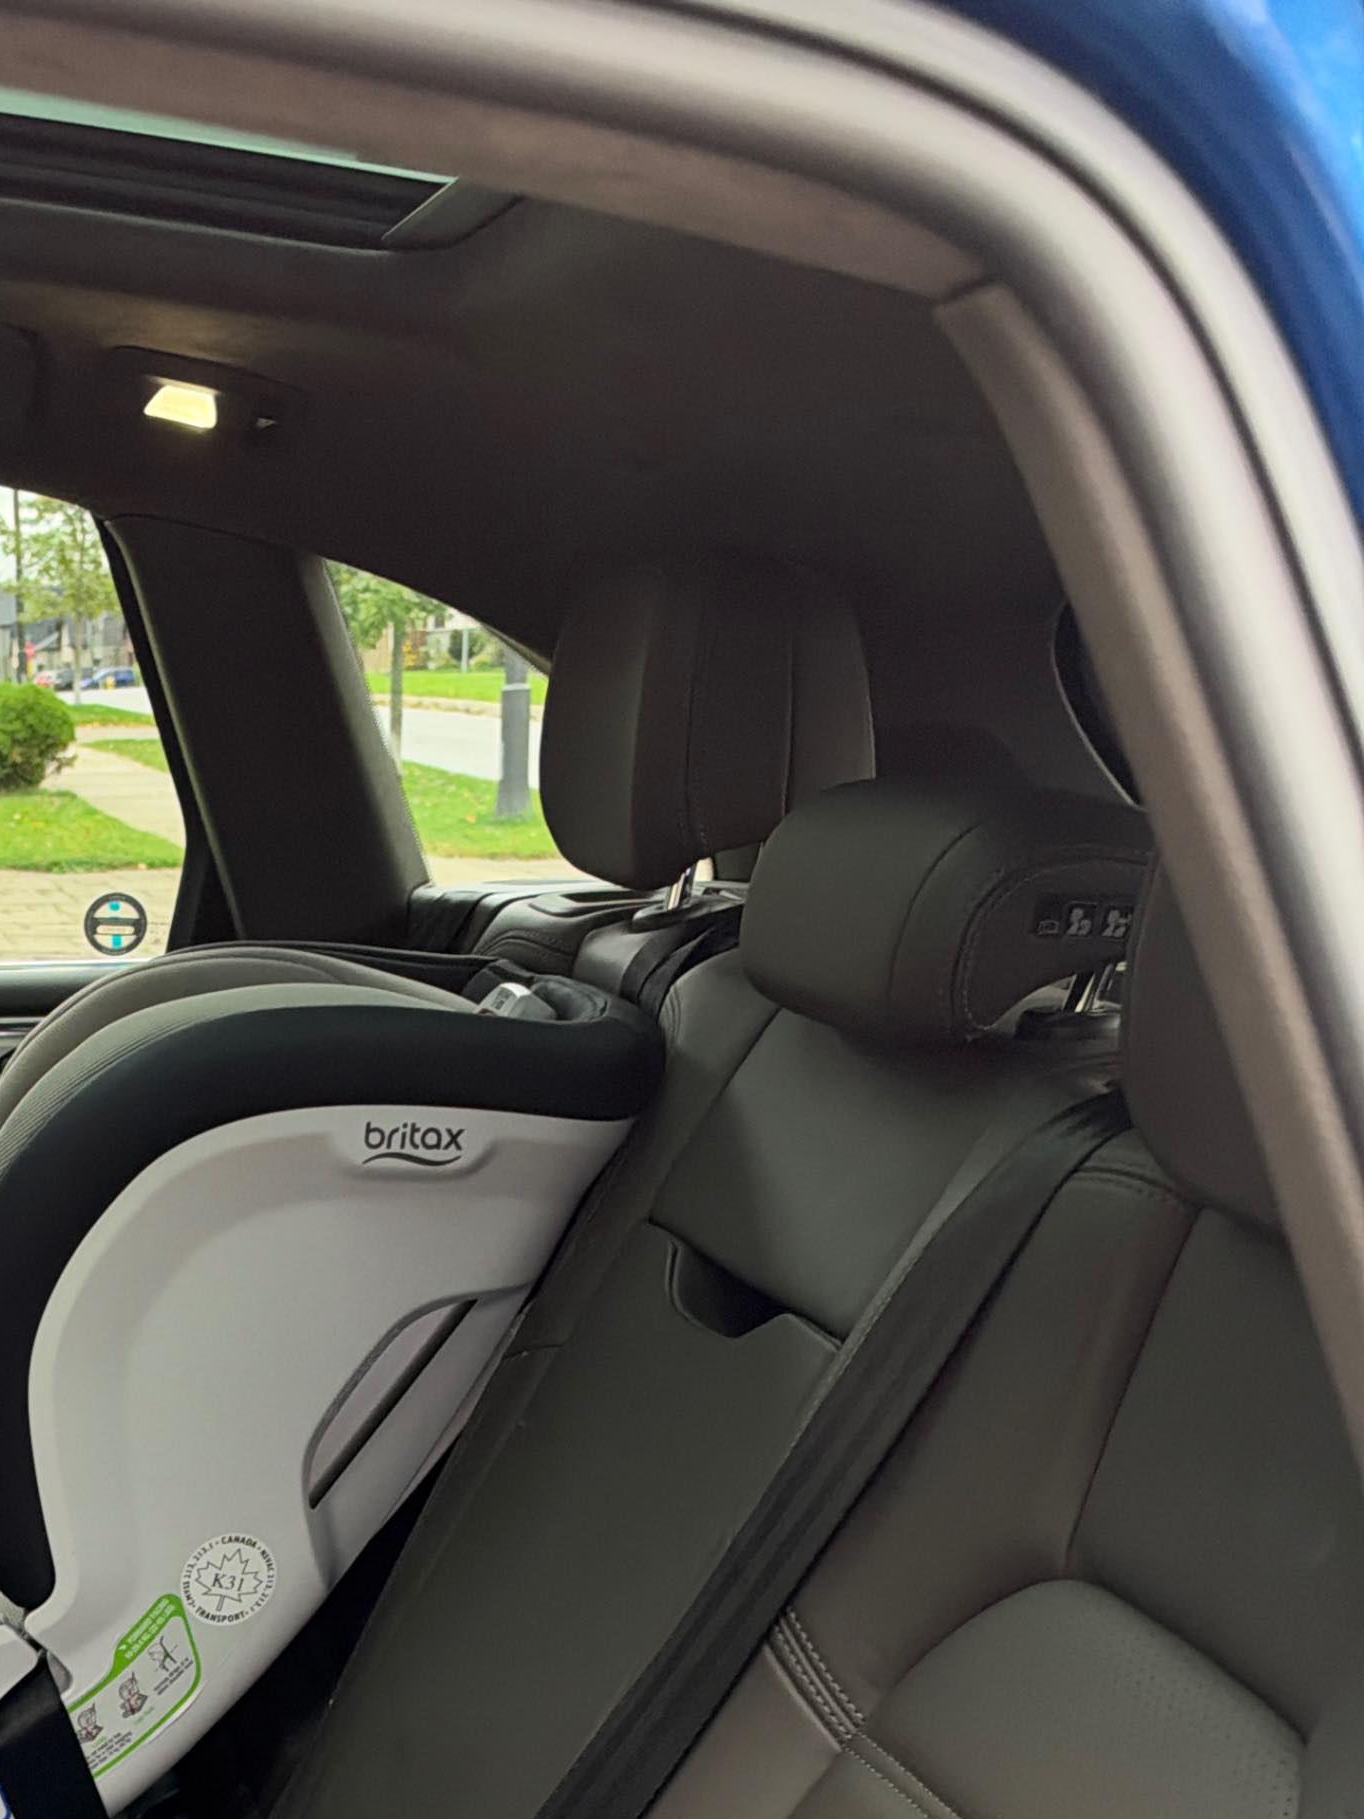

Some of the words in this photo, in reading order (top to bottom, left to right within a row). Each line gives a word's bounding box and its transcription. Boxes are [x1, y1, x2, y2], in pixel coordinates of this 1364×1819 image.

[364, 1121, 465, 1151] britax
[221, 1536, 258, 1549] CANADA
[211, 1572, 244, 1592] K31
[195, 1606, 245, 1623] TRANSPORT
